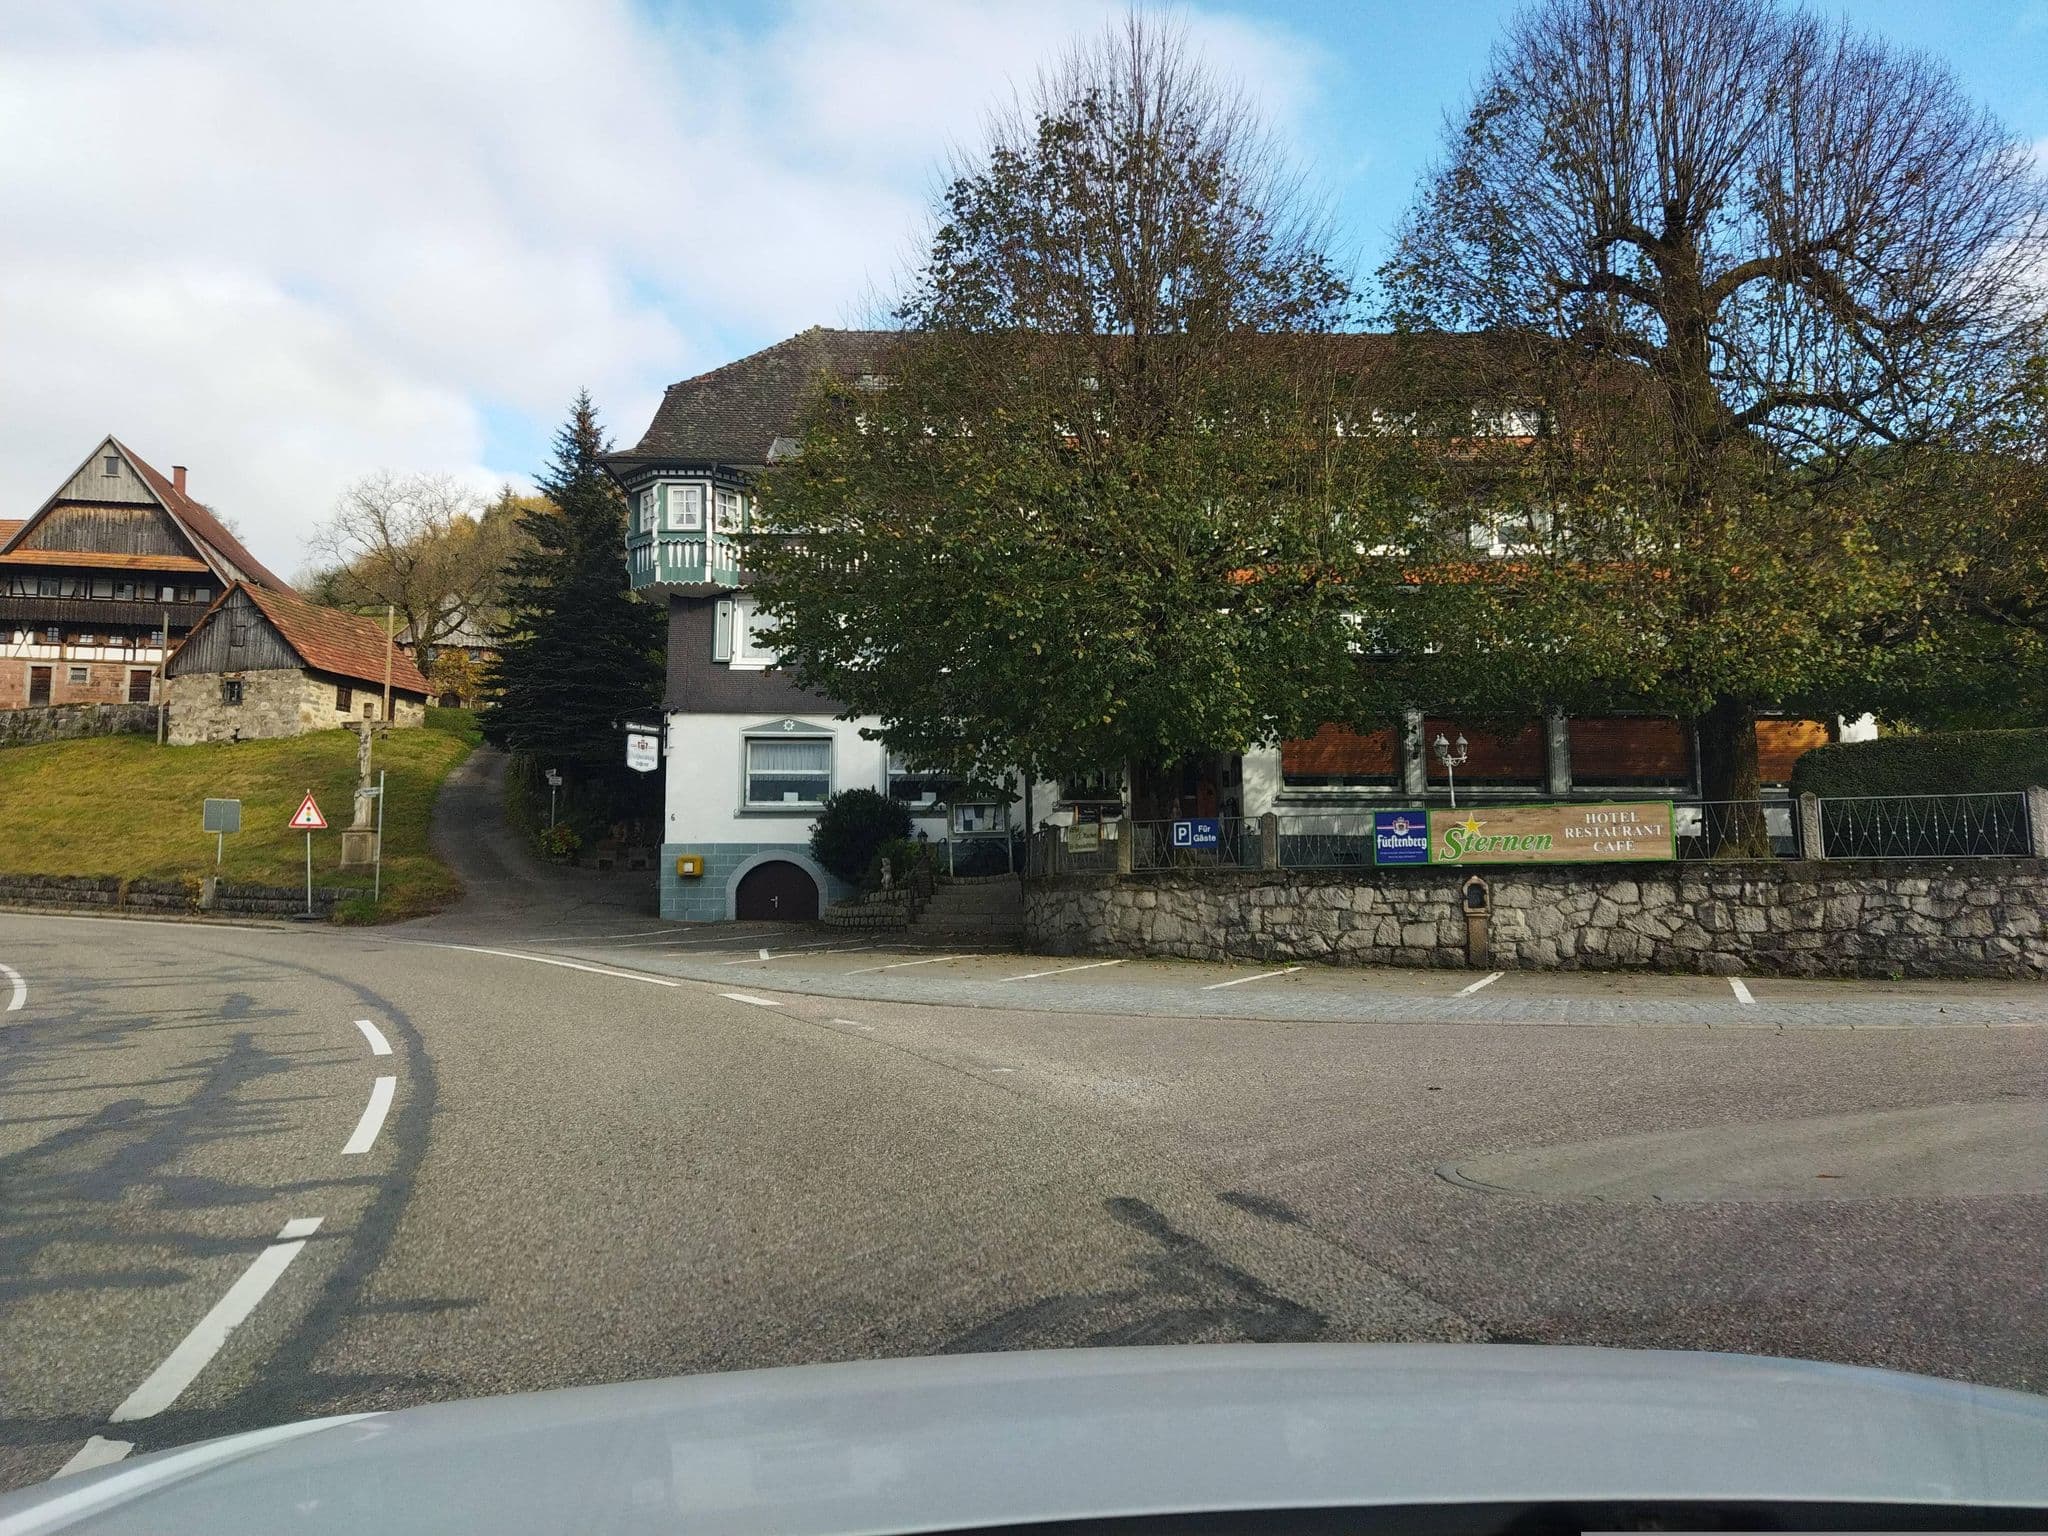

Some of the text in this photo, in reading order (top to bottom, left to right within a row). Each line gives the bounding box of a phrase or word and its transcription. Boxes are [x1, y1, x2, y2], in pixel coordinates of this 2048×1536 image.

[1585, 811, 1640, 824] HOTEL
[1178, 827, 1188, 841] P
[1198, 824, 1211, 833] Für
[1565, 824, 1664, 839] RESTAURANT
[1193, 834, 1217, 842] Gäste
[1377, 834, 1427, 850] Fürstenberg
[1438, 827, 1553, 861] Sternen
